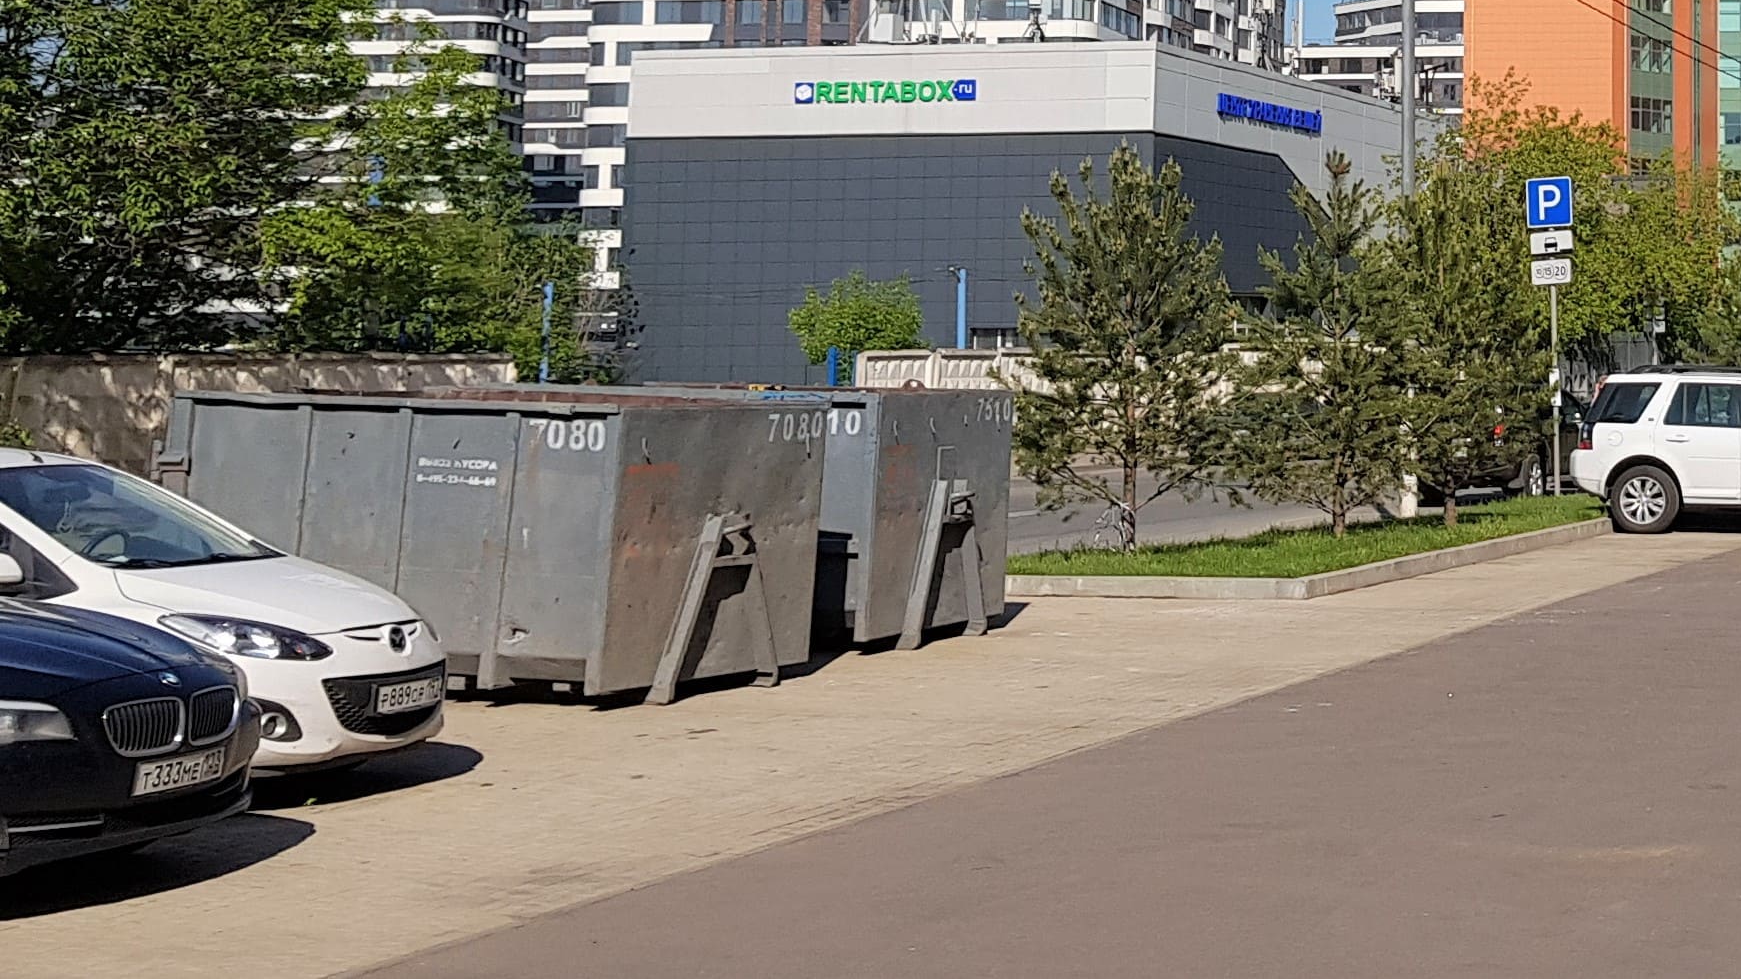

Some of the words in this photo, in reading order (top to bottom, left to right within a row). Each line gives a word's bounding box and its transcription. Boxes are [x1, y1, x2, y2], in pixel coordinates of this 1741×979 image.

[1538, 184, 1561, 221] P
[1555, 265, 1566, 277] 20
[528, 419, 606, 452] 7080
[768, 411, 823, 443] 7080
